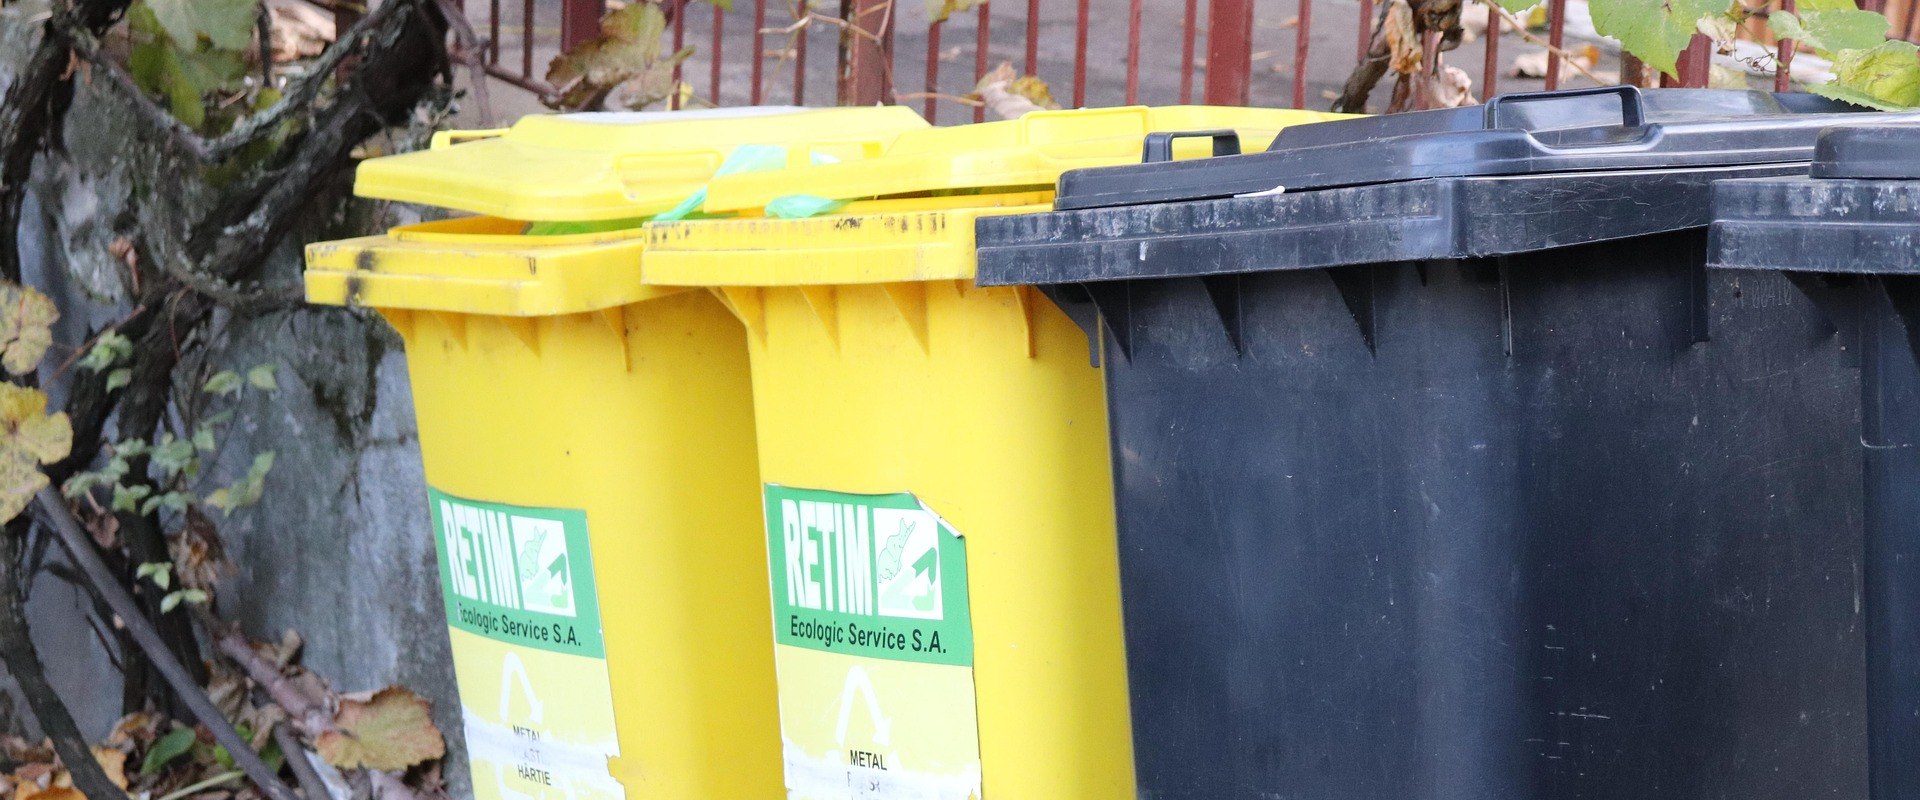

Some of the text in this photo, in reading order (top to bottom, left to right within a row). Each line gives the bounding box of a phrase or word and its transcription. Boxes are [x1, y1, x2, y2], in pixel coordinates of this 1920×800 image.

[440, 499, 520, 610] RETIM
[782, 498, 873, 616] RETIM
[502, 614, 549, 641] Service
[553, 623, 581, 646] S.A.
[791, 615, 947, 654] Ecologic Service S.A.
[850, 749, 888, 771] METAL
